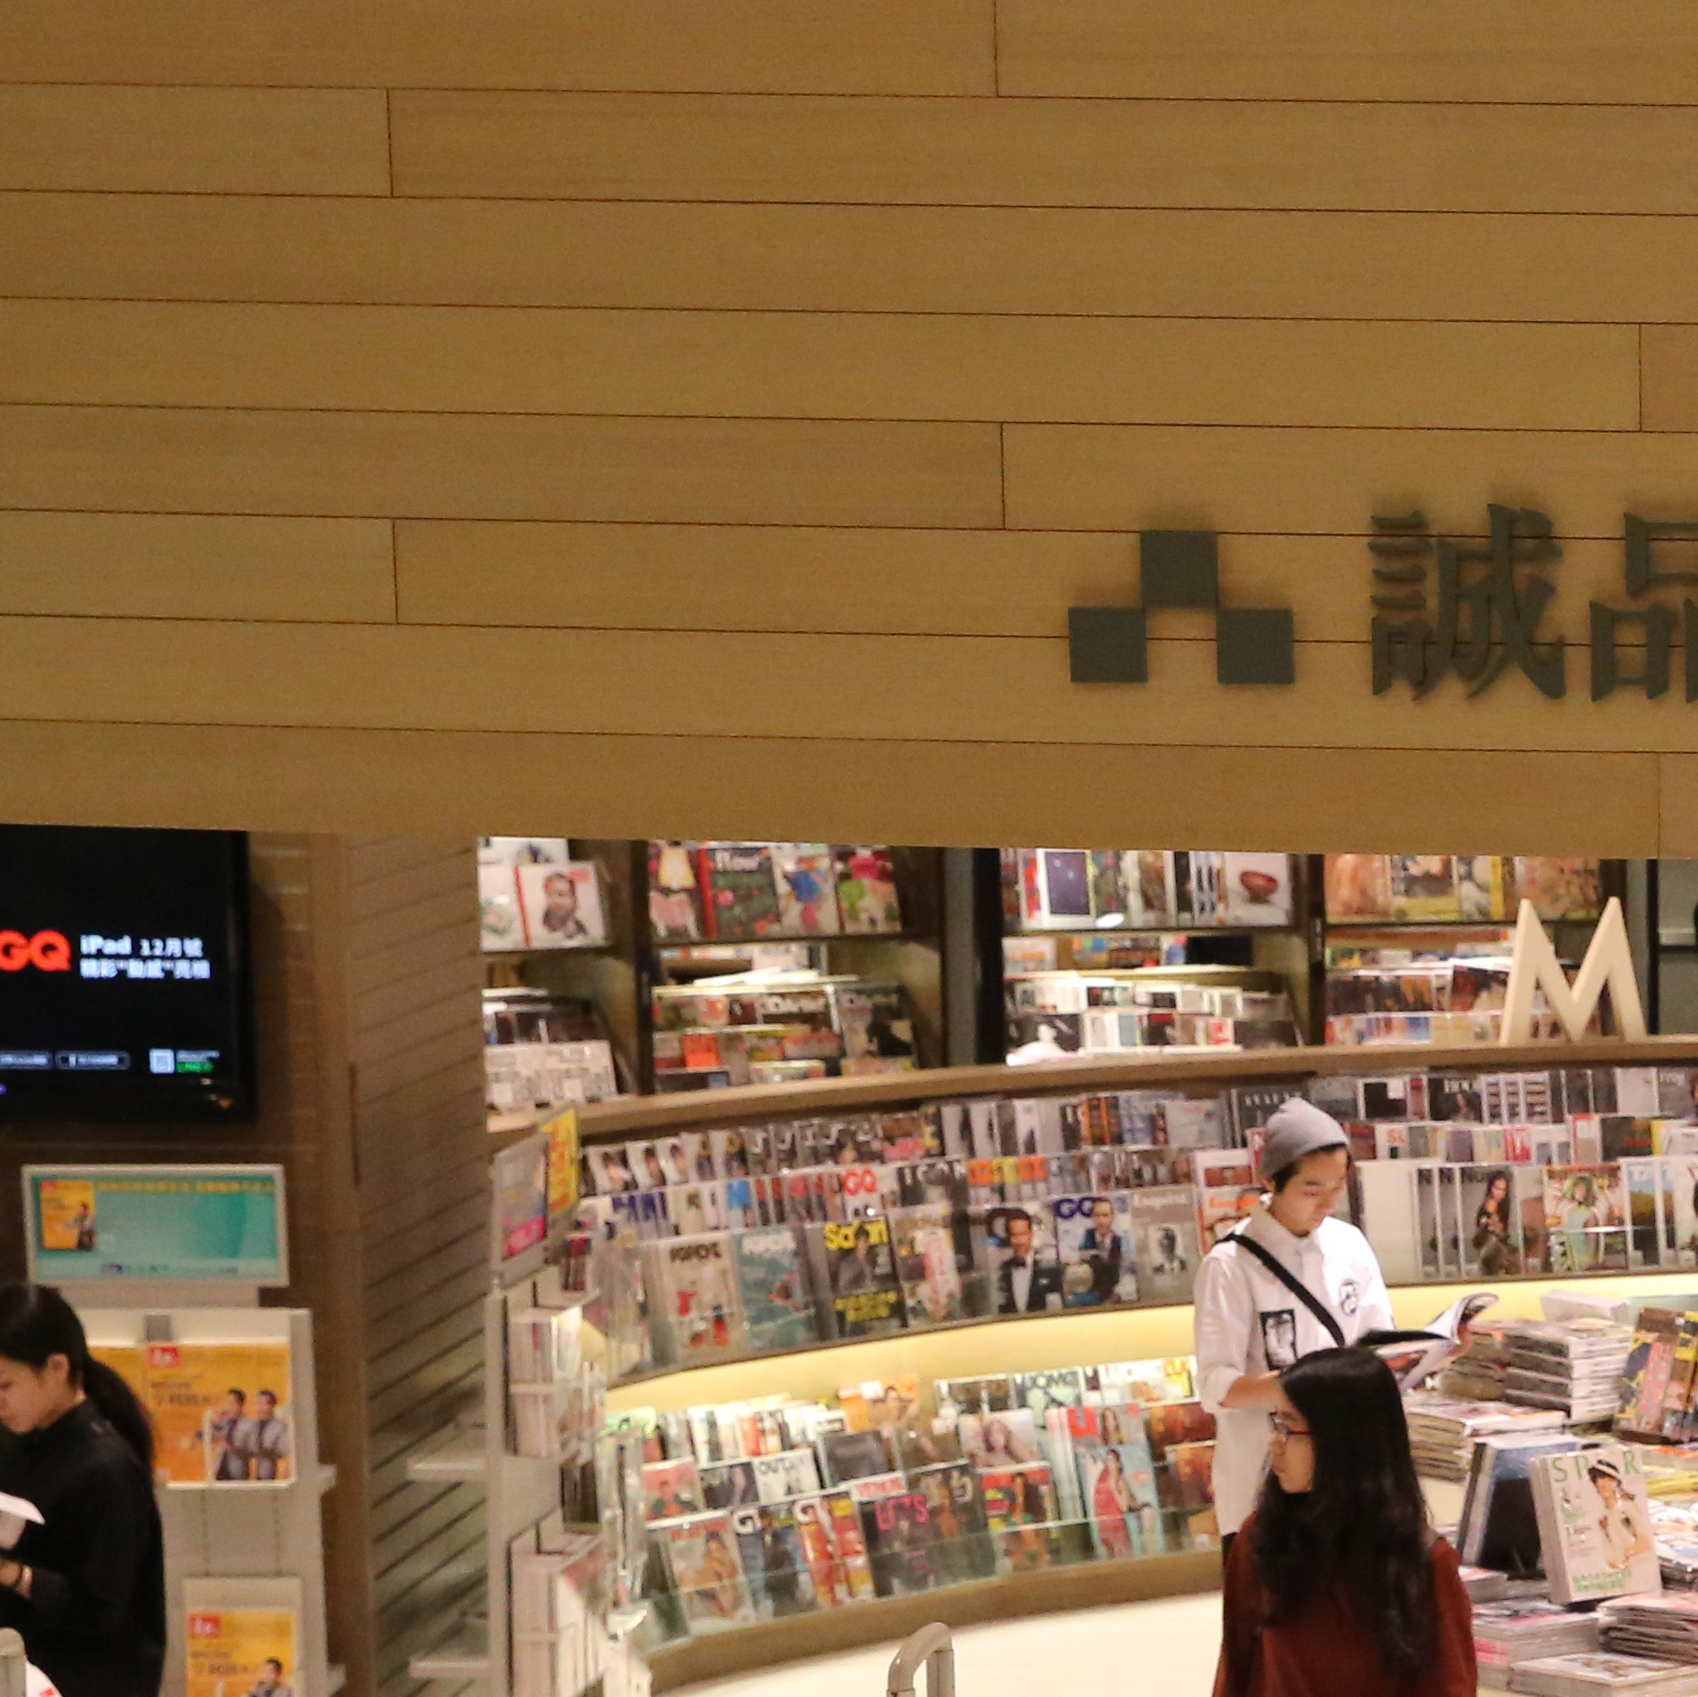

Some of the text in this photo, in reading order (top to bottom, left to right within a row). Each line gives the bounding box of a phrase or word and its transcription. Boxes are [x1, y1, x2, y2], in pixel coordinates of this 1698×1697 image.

[0, 929, 71, 972] GQ
[80, 935, 132, 956] iPad
[843, 1168, 878, 1197] GQ
[1551, 1450, 1640, 1484] SPR
